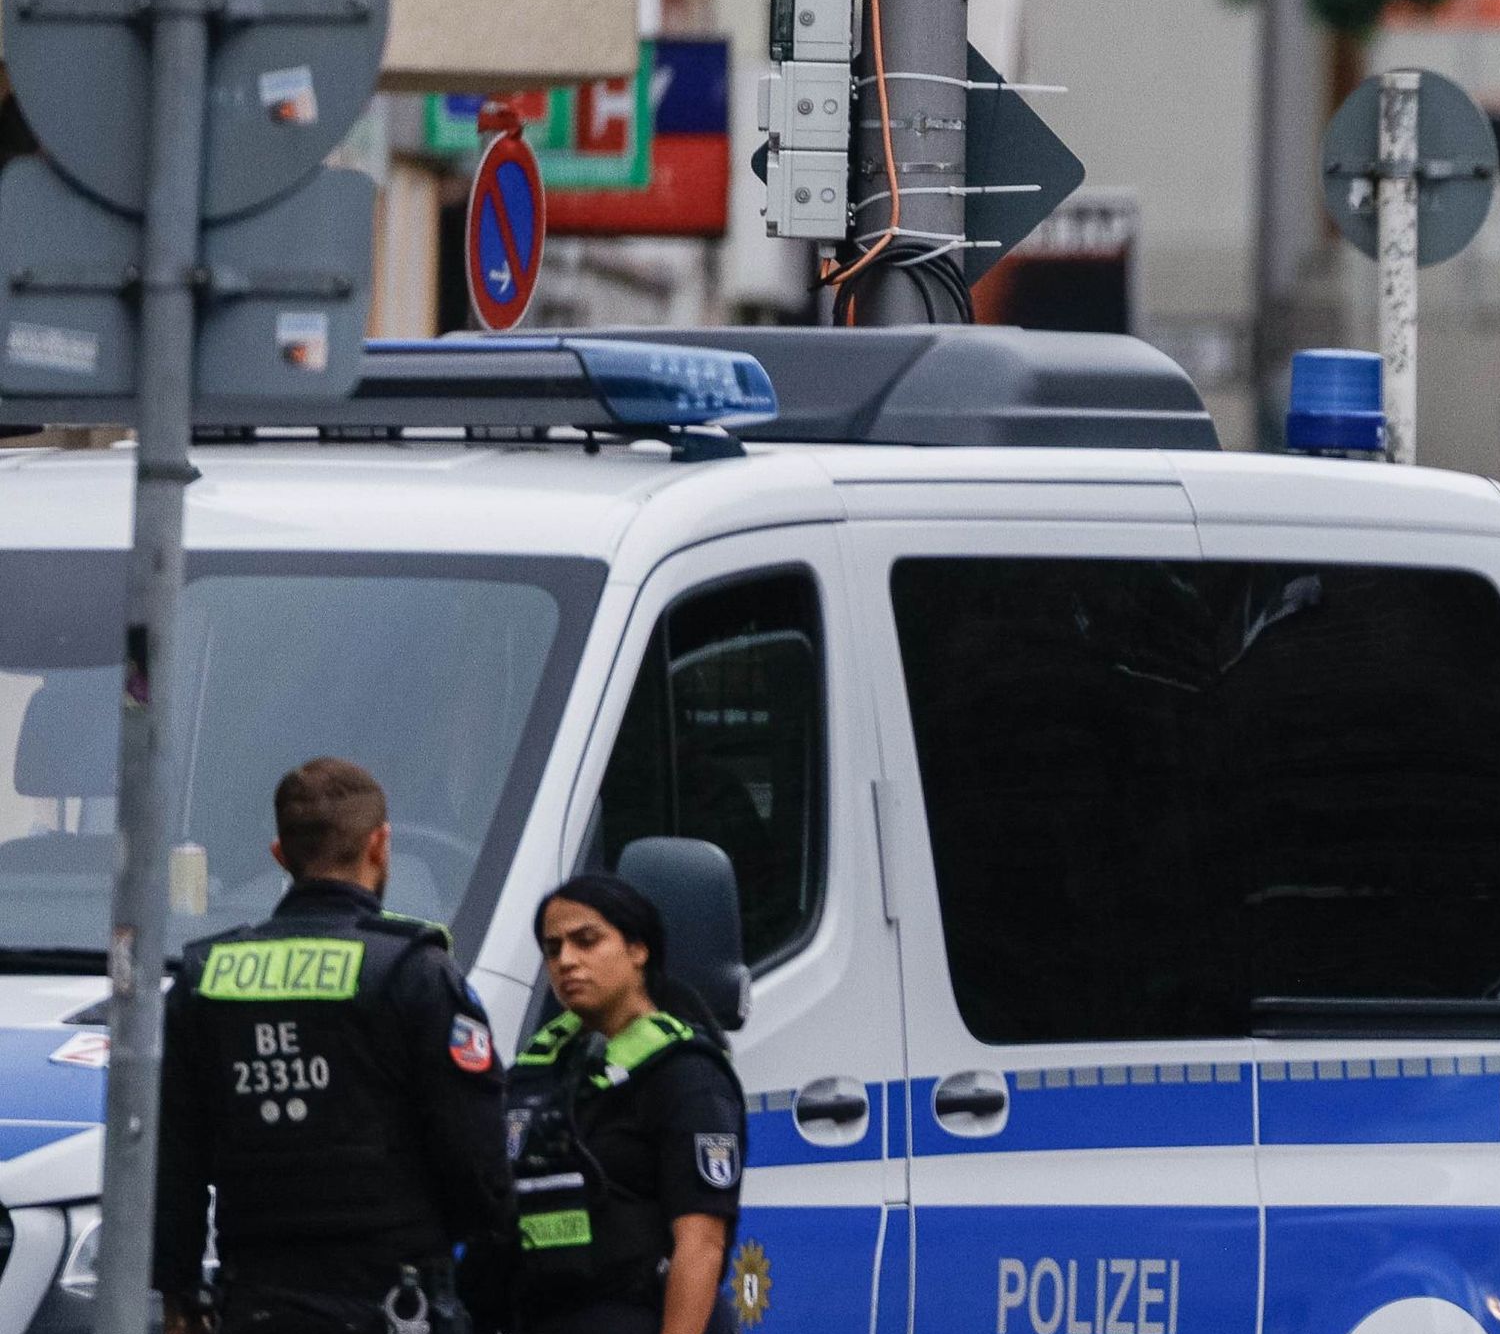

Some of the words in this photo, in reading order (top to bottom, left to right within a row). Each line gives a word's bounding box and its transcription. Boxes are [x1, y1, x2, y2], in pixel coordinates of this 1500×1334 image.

[210, 947, 355, 994] POLIZEI
[254, 1021, 301, 1057] BE
[232, 1055, 331, 1095] 23310
